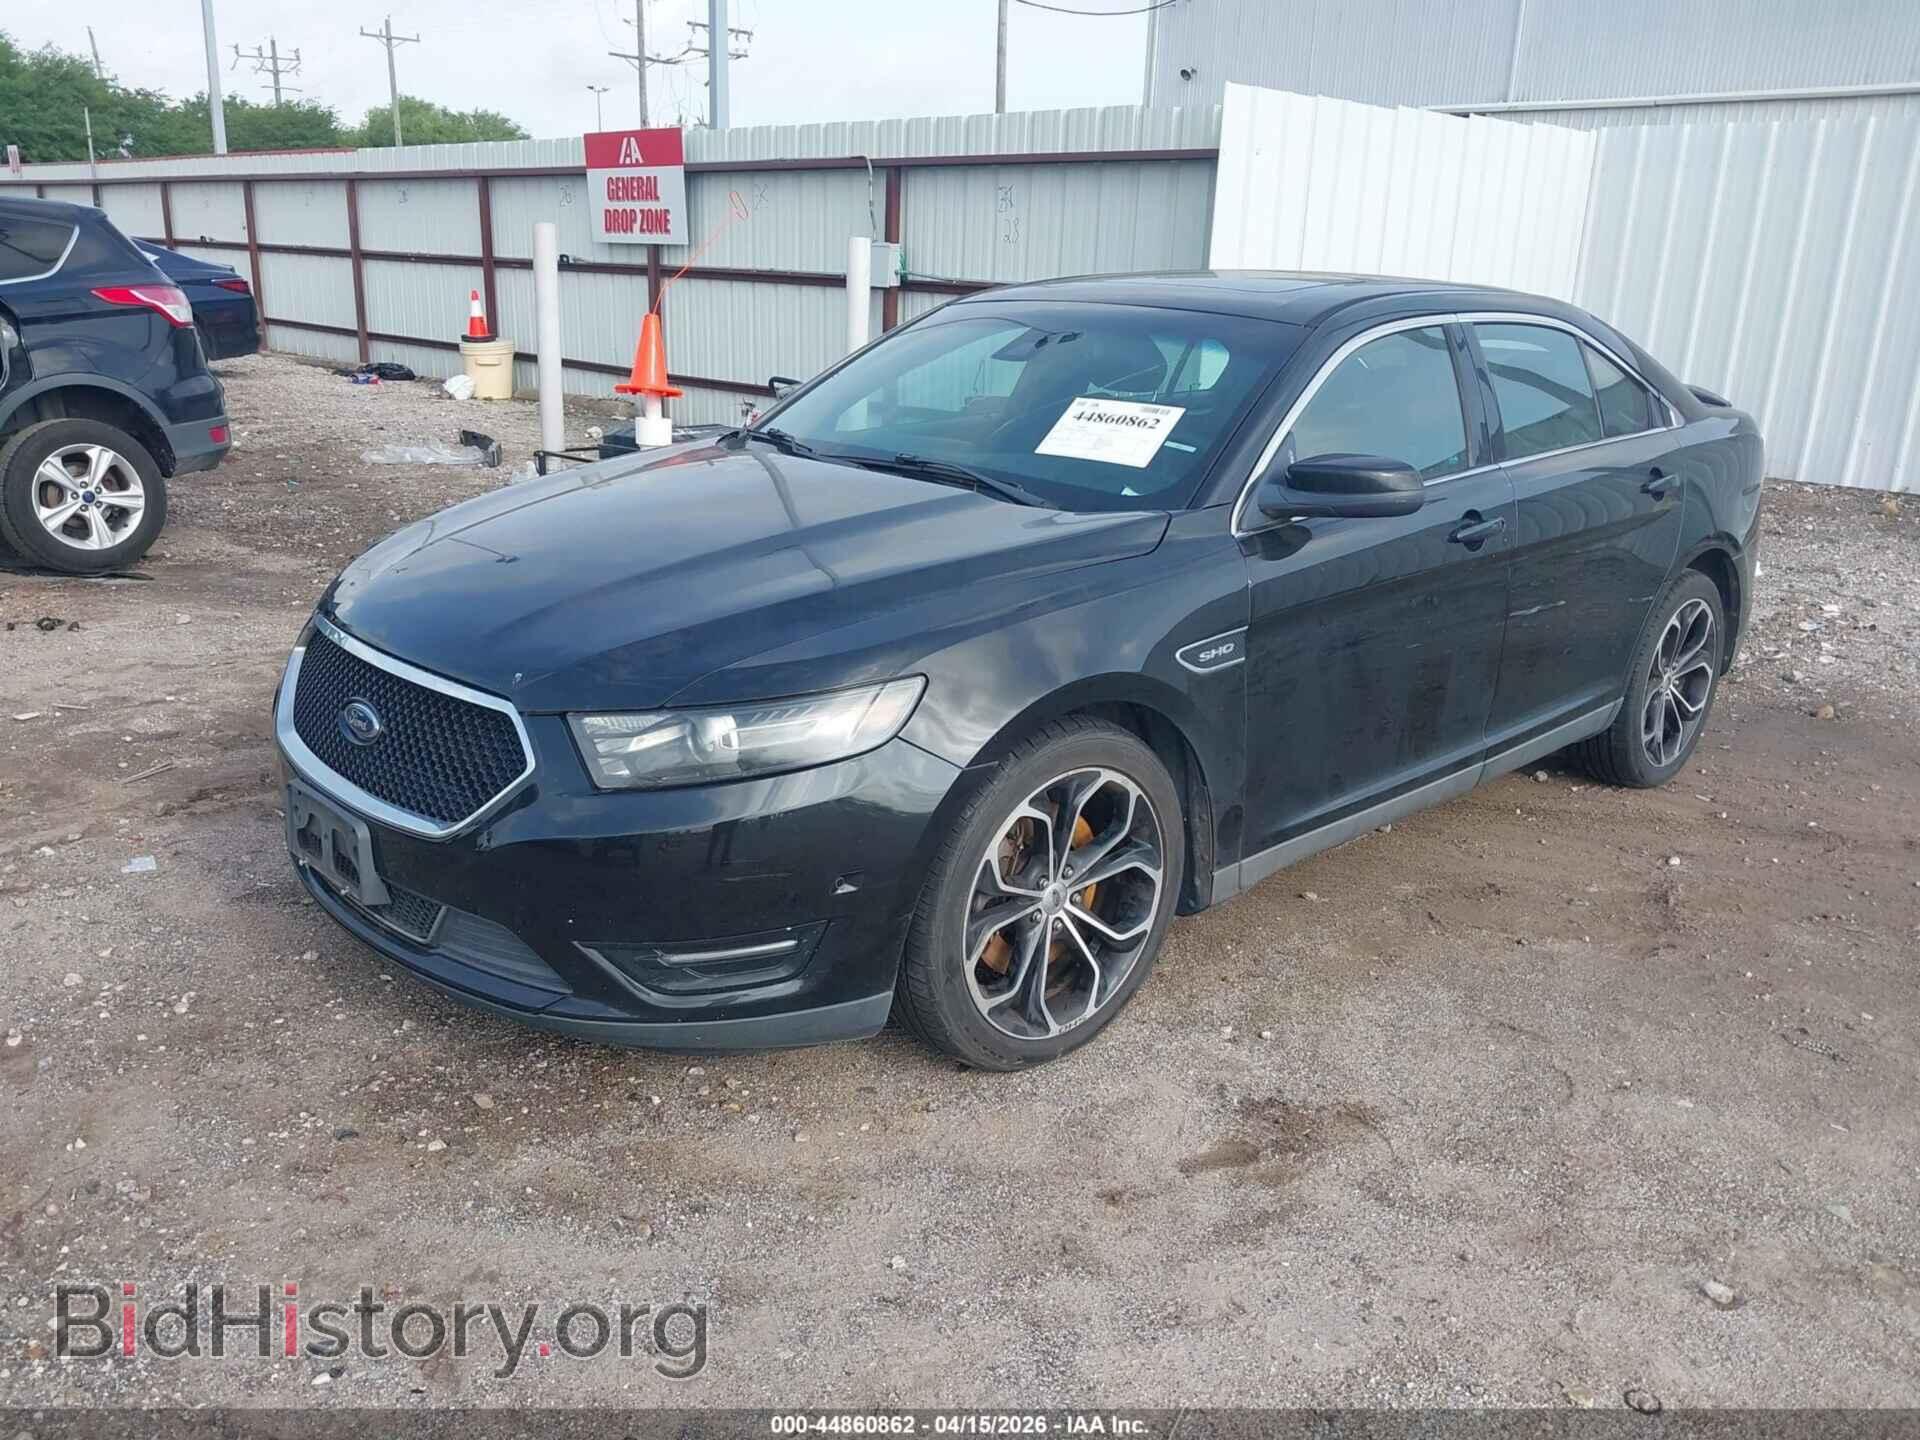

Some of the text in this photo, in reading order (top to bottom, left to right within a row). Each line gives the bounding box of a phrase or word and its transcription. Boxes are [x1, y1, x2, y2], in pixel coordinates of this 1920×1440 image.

[606, 175, 661, 202] GENERAL
[604, 208, 672, 235] DROP ZONE
[1072, 410, 1161, 430] 44860862
[1199, 643, 1235, 661] SHO
